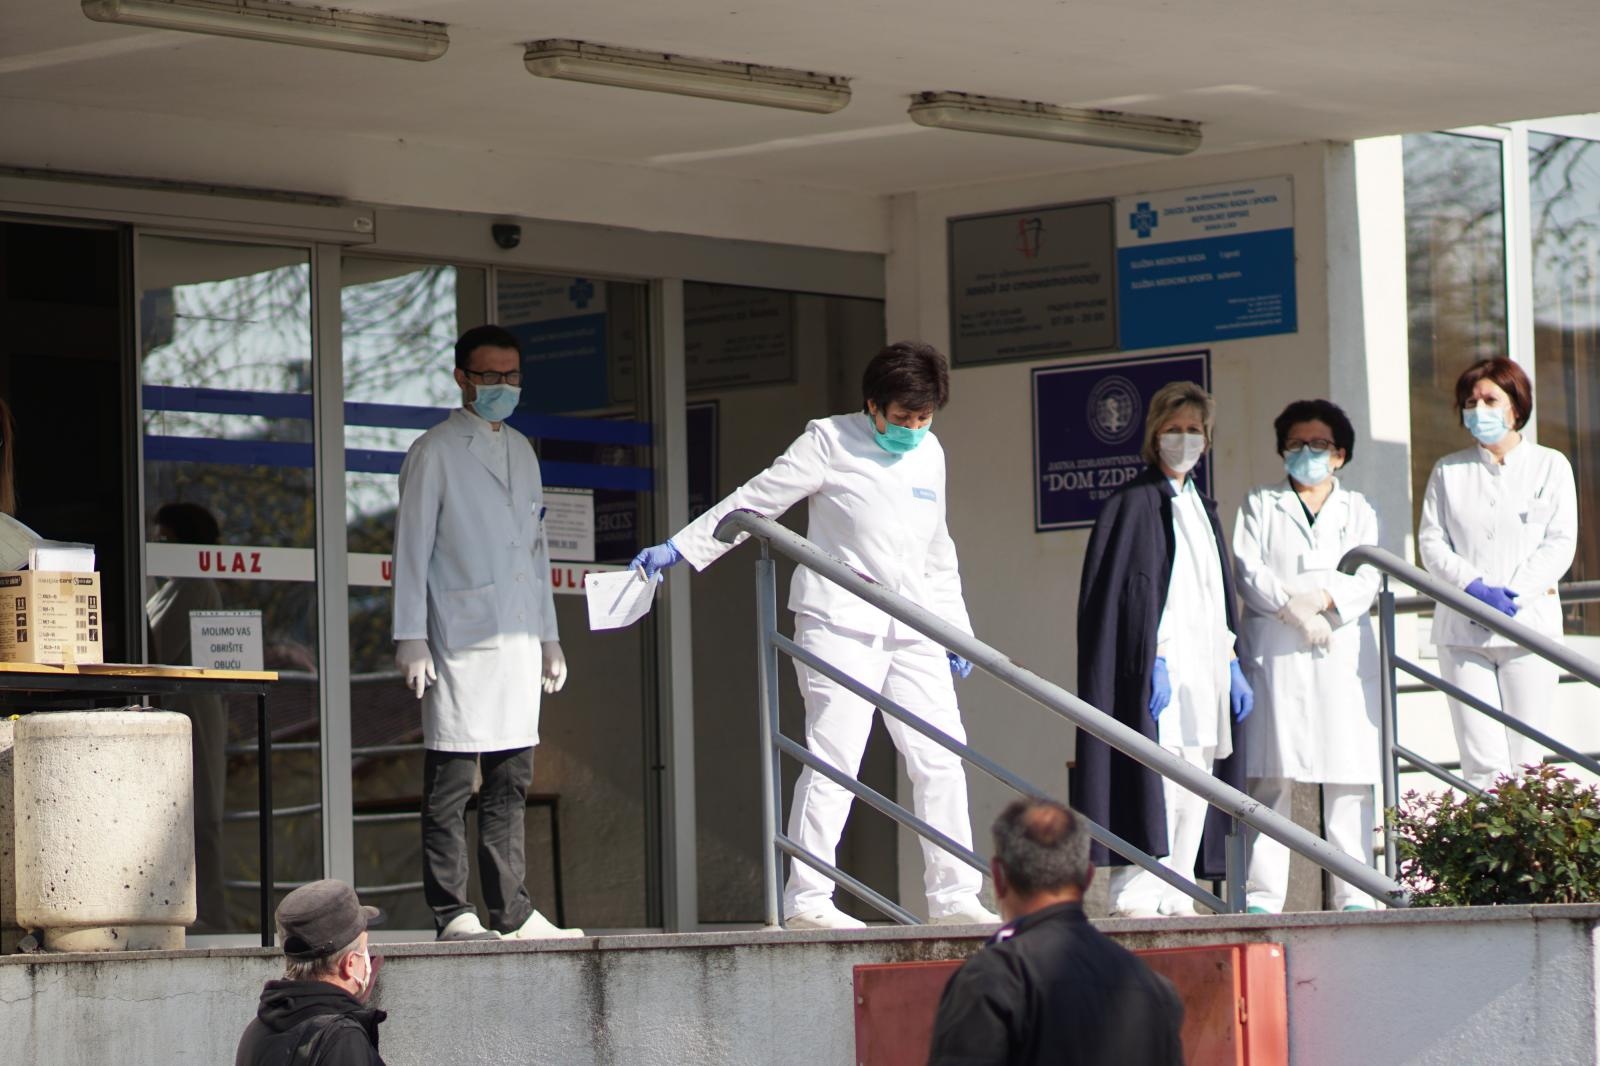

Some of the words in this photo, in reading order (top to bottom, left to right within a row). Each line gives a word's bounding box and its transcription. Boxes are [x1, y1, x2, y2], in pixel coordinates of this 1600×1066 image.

[199, 551, 261, 573] ULAZ
[201, 627, 235, 636] MOLIMO
[236, 627, 251, 636] VAS
[210, 642, 243, 653] OBRIŠITE
